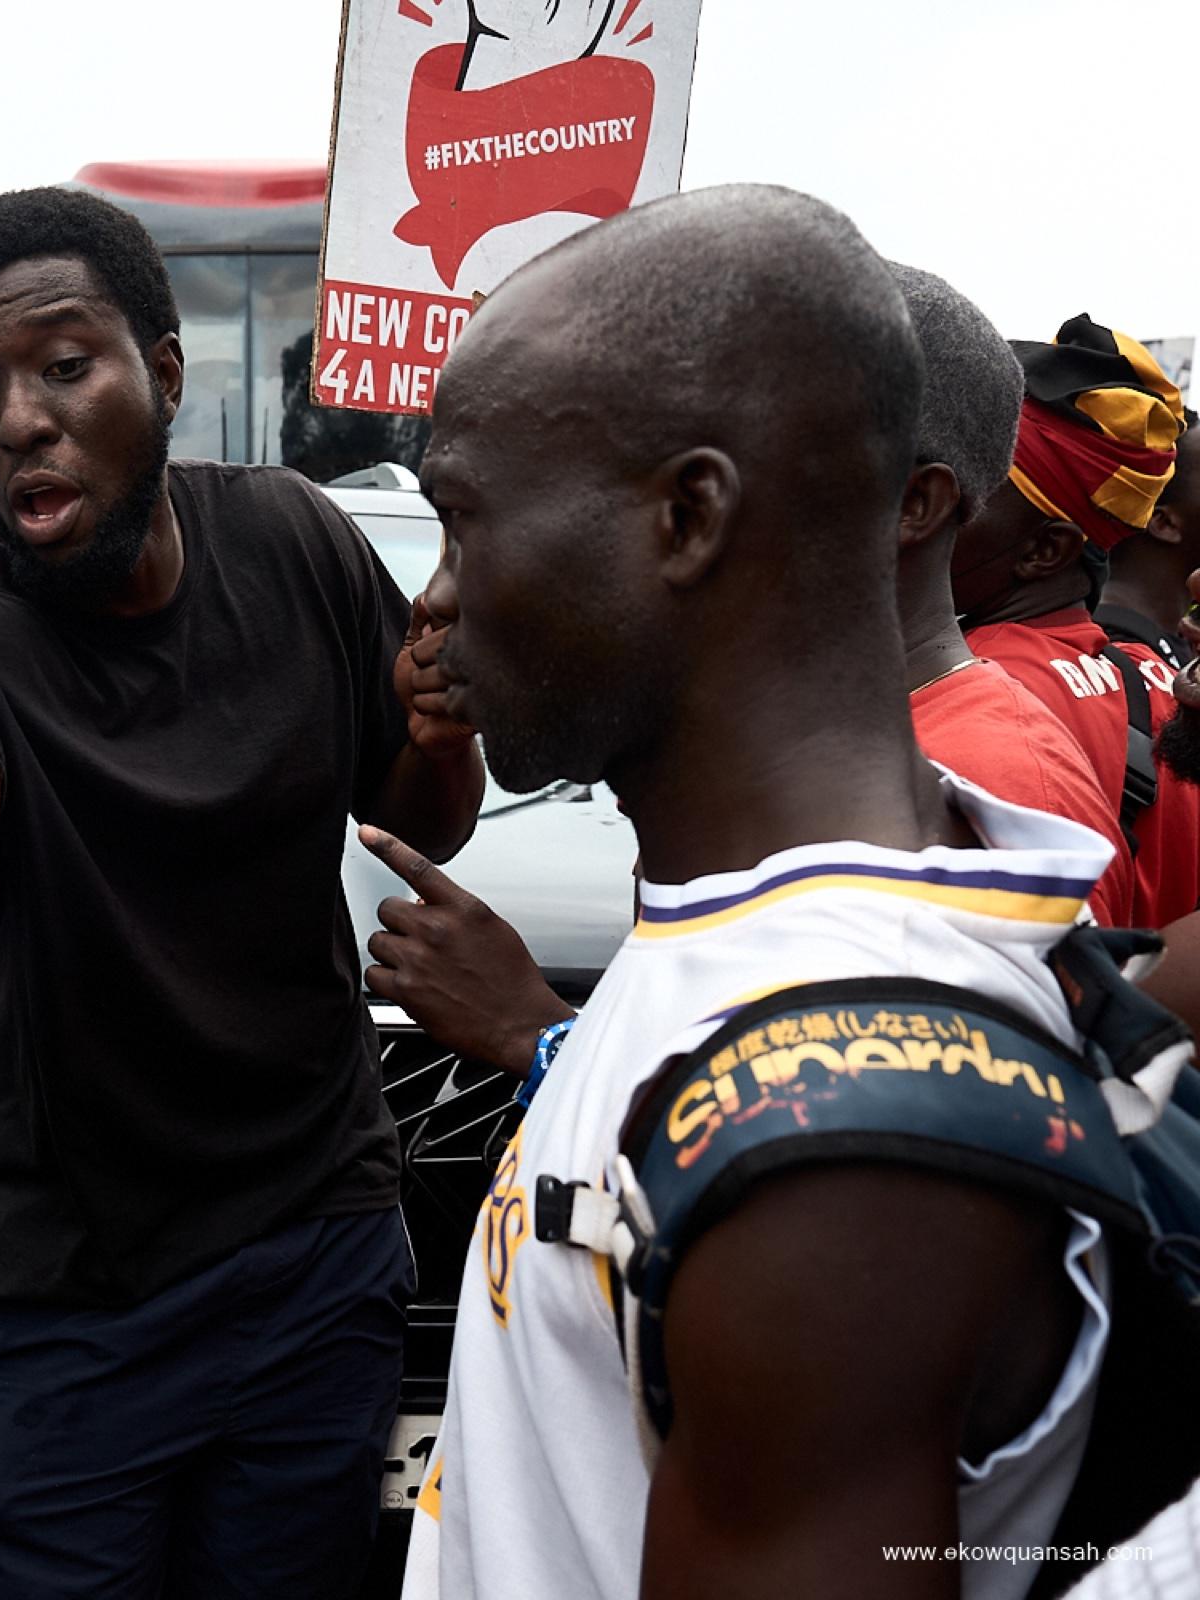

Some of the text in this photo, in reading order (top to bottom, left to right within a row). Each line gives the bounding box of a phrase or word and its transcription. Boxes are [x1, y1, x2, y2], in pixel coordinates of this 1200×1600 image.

[424, 116, 637, 171] #FIXTHECOUNTRY
[326, 289, 412, 350] NEW
[388, 362, 440, 409] NE
